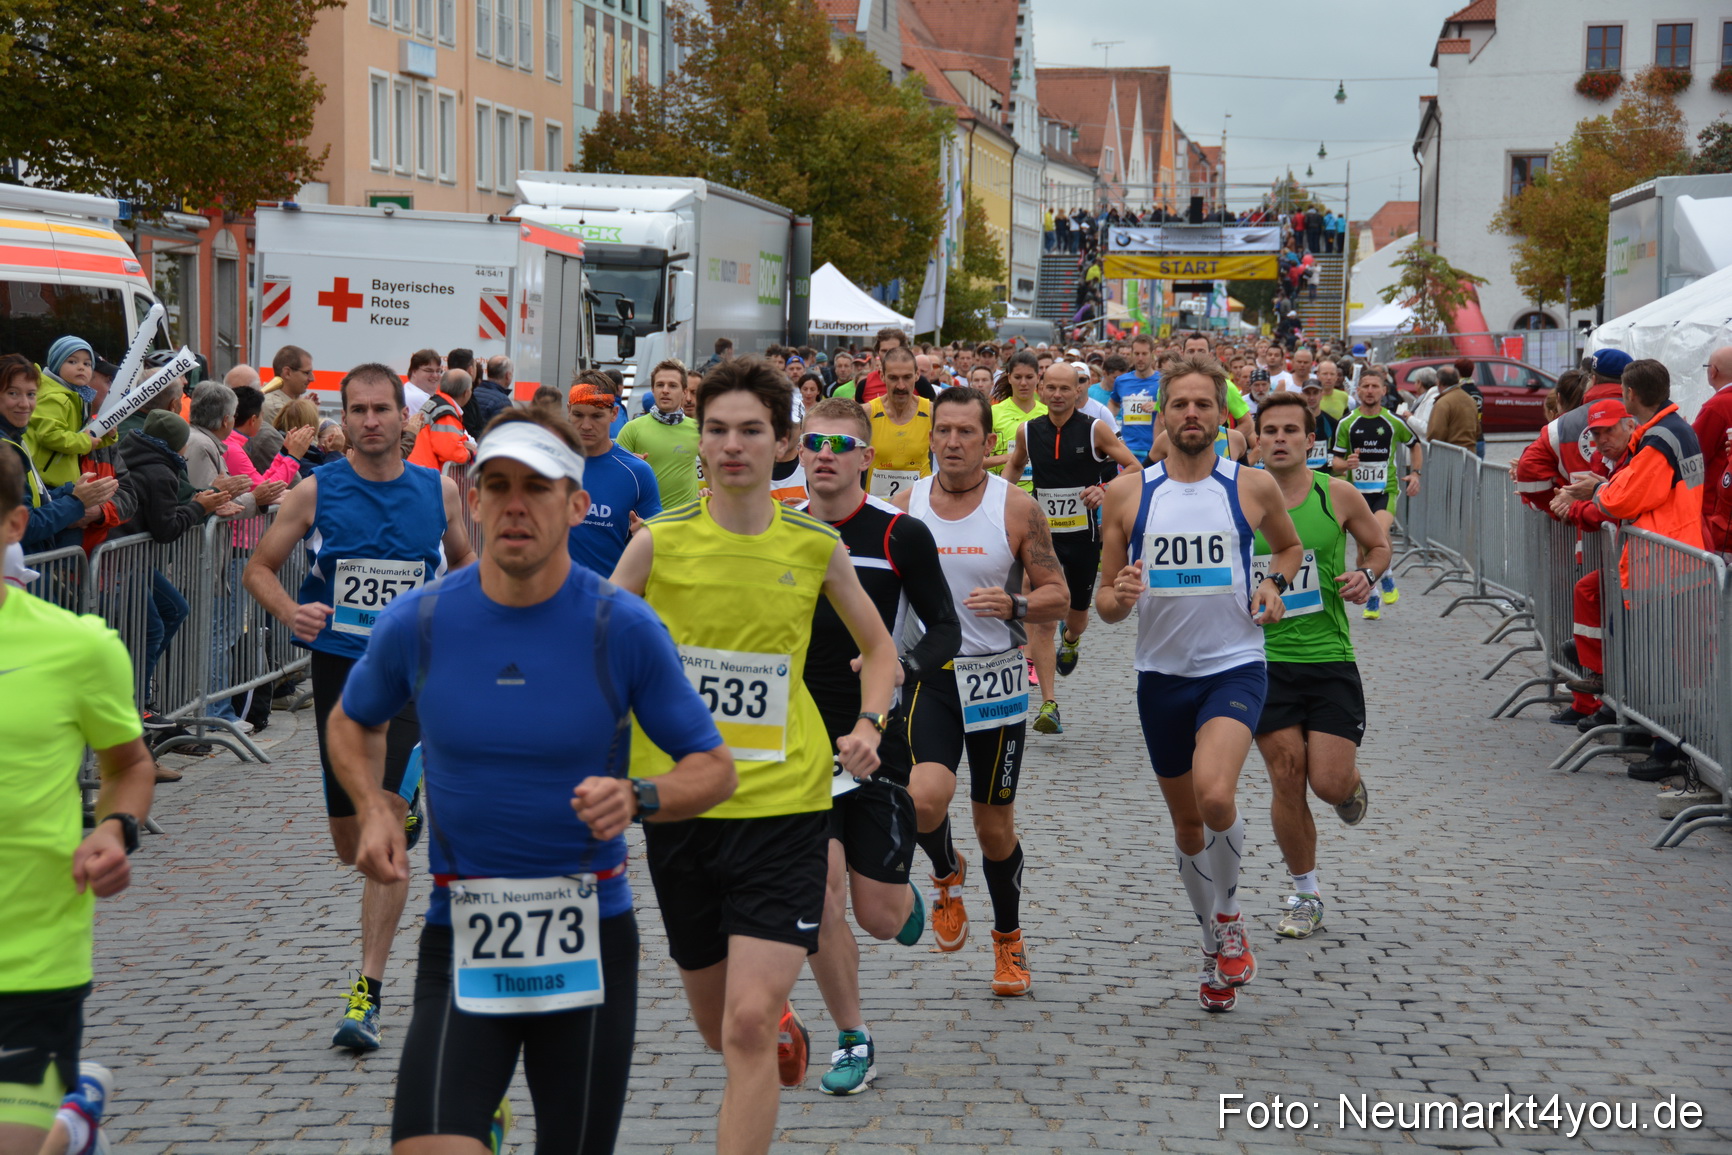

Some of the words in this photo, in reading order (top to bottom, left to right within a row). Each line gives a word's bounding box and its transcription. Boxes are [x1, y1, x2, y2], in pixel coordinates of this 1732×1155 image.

[475, 269, 504, 278] 44/54/1
[1160, 260, 1219, 274] START
[372, 279, 454, 295] Bayerisches
[371, 296, 410, 310] Rotes
[370, 314, 410, 326] Kreuz
[815, 320, 869, 332] Laufsport
[100, 358, 191, 430] bmw-laufsport.de
[1355, 468, 1384, 480] 3014
[1048, 499, 1076, 516] 372
[1154, 534, 1224, 566] 2016
[338, 565, 367, 574] PARTL
[370, 567, 410, 576] Neumarkt
[1176, 573, 1202, 584] Tom
[680, 656, 717, 670] PARTL
[720, 661, 773, 674] Neumarkt
[956, 663, 984, 672] PARTL
[966, 664, 1024, 702] 2207
[699, 675, 768, 718] 533
[978, 702, 1022, 718] Wolfgang
[455, 892, 499, 905] PARTL
[503, 888, 572, 904] Neumarkt
[469, 906, 584, 960] 2273
[494, 973, 565, 992] Thomas
